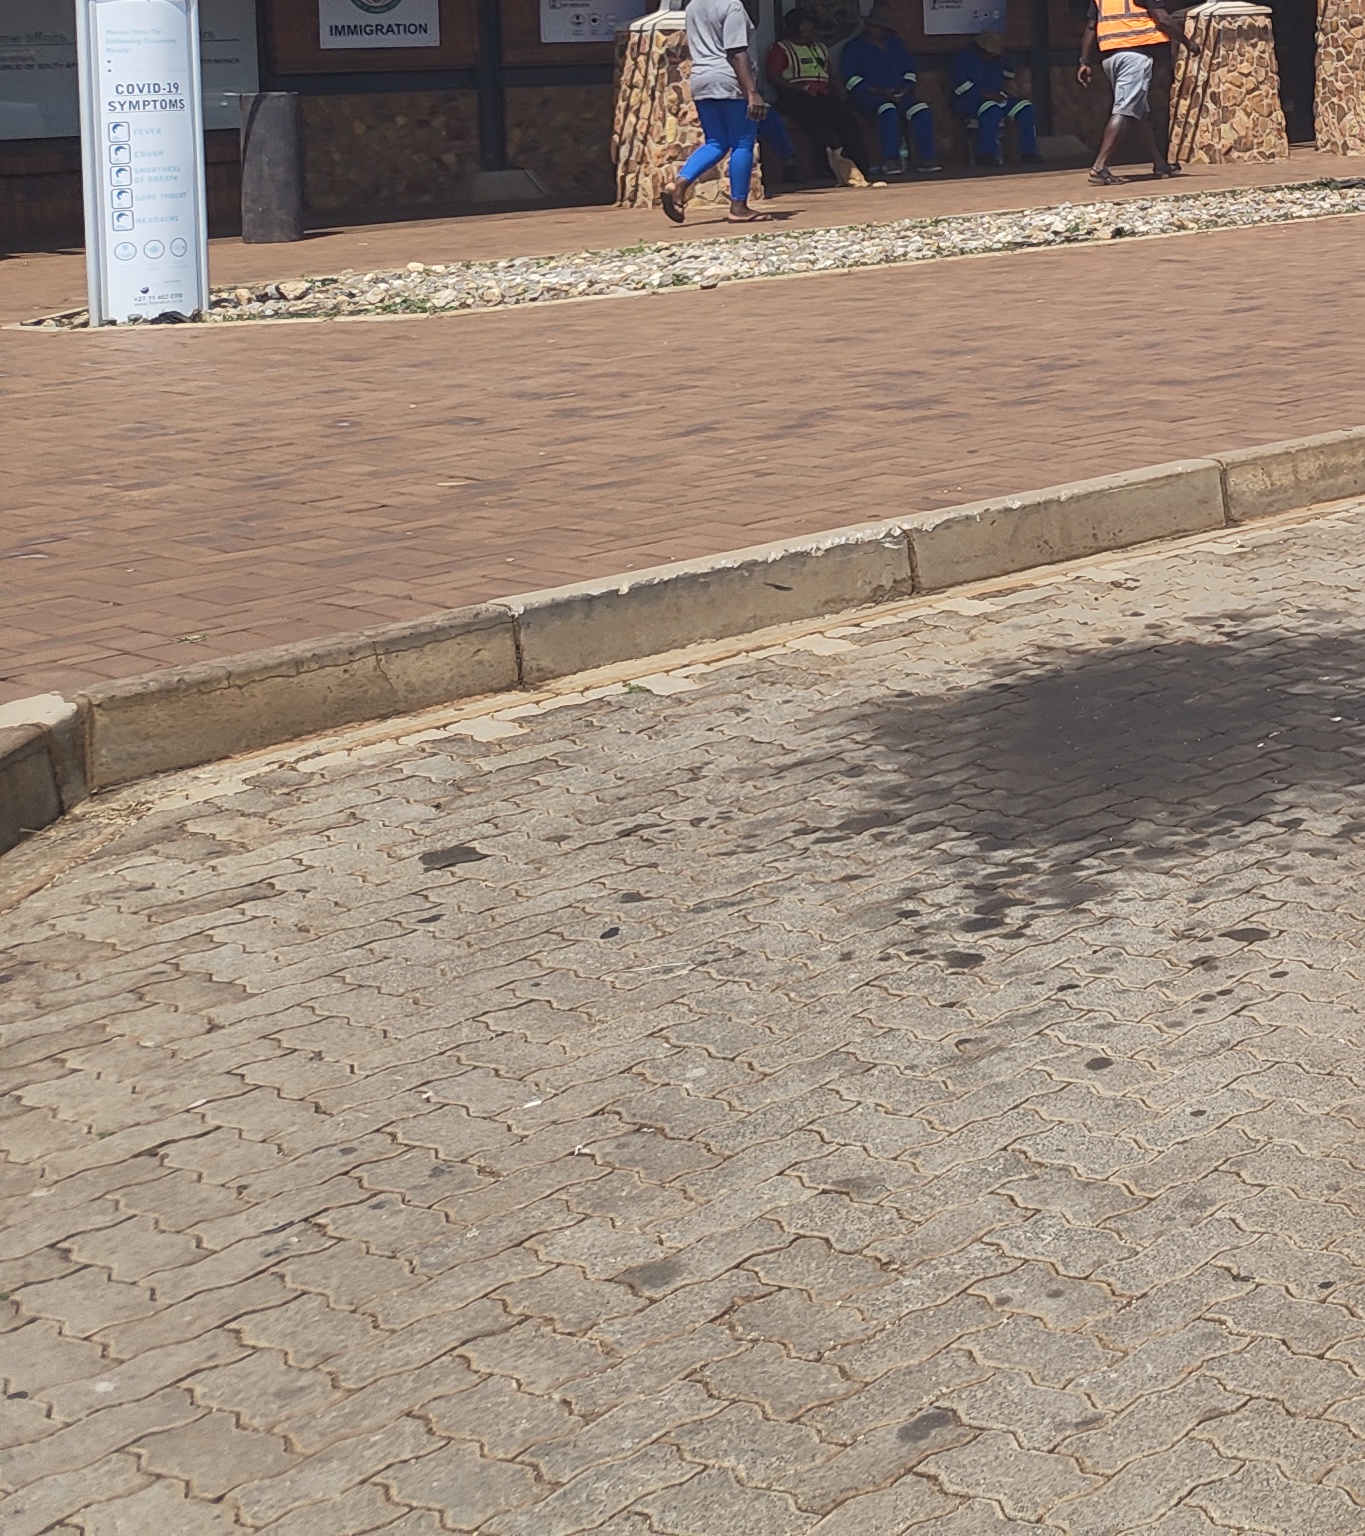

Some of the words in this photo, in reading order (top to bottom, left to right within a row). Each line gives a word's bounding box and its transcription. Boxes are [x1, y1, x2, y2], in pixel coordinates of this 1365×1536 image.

[329, 23, 428, 37] IMMIGRATION
[115, 81, 180, 95] COVID-19
[107, 98, 186, 112] SYMPTOMS
[133, 127, 162, 135] FEVER
[134, 149, 164, 158] COUGH
[135, 193, 157, 202] SORE
